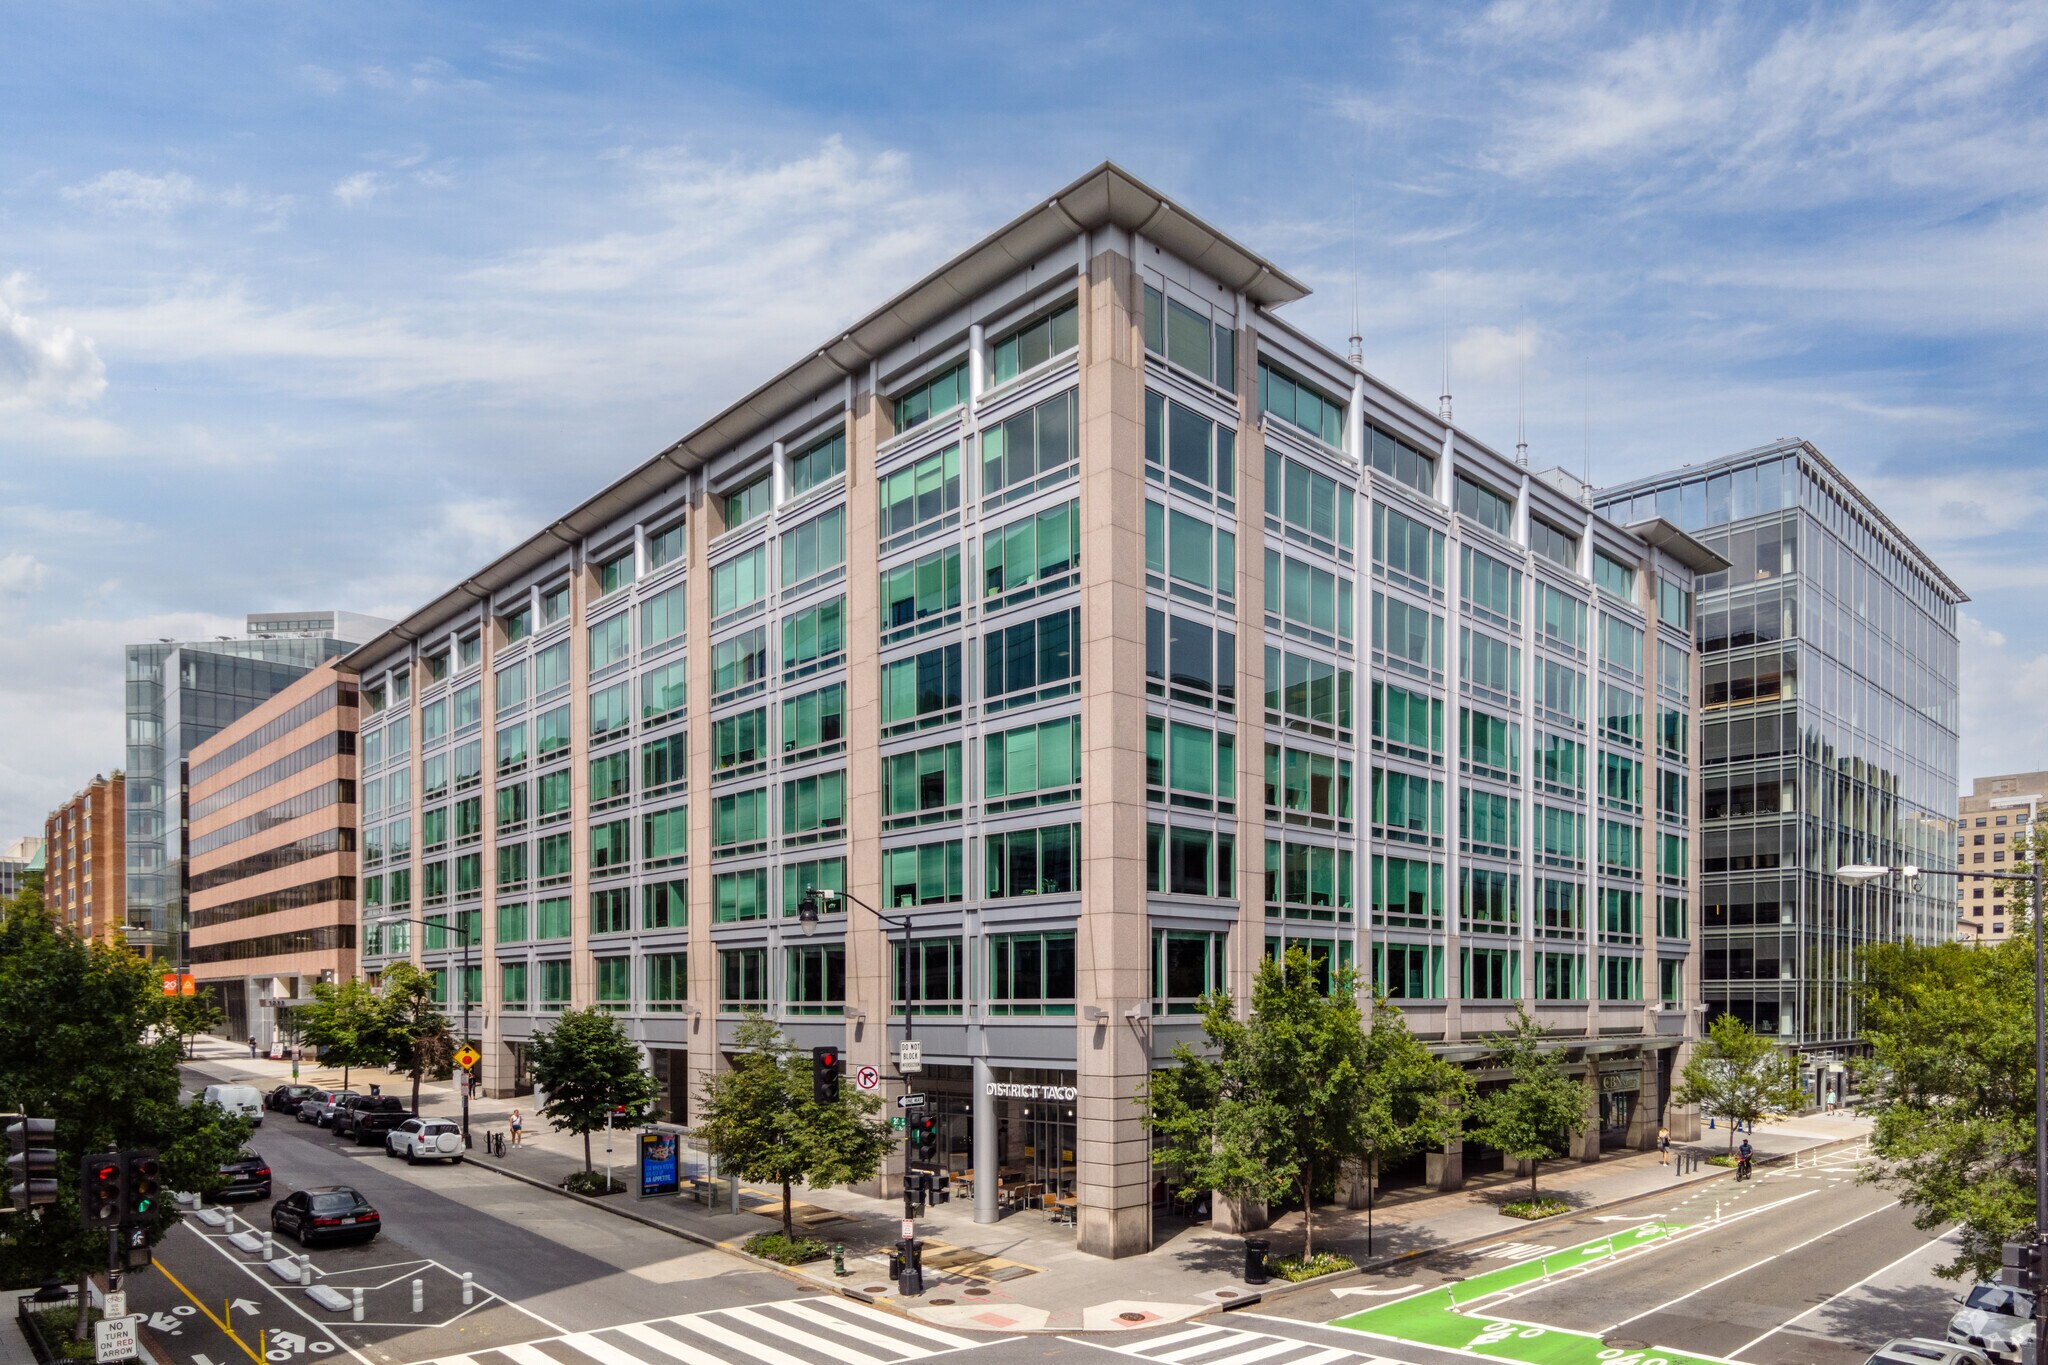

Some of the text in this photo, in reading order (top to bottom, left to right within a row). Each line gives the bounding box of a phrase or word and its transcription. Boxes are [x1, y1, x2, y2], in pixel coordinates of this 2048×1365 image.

[901, 1043, 920, 1051] DO NOT
[903, 1052, 918, 1060] BLOCK
[986, 1083, 1077, 1101] DISTRICT TACO
[109, 1322, 123, 1331] NO
[105, 1331, 128, 1340] TURN
[100, 1338, 134, 1350] ON RED
[102, 1347, 133, 1358] ARROW
